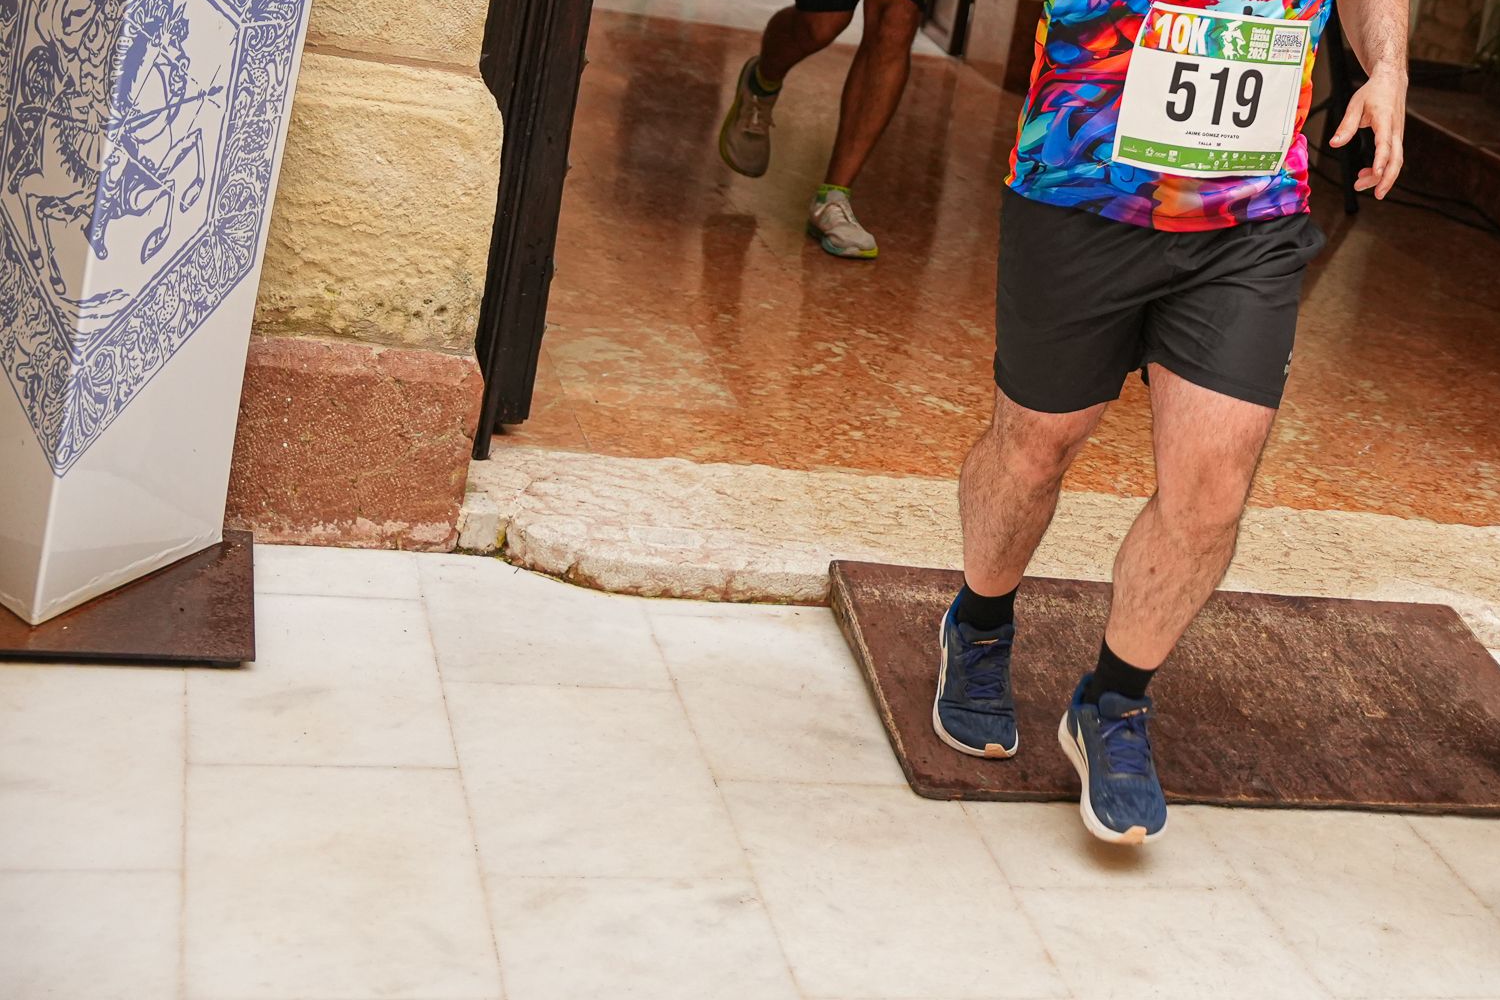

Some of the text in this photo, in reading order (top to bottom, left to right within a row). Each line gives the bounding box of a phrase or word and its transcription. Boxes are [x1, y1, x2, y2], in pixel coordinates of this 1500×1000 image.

[1154, 13, 1212, 56] 10K
[1272, 39, 1302, 48] populares
[1274, 33, 1300, 42] carreras
[1166, 61, 1264, 128] 519
